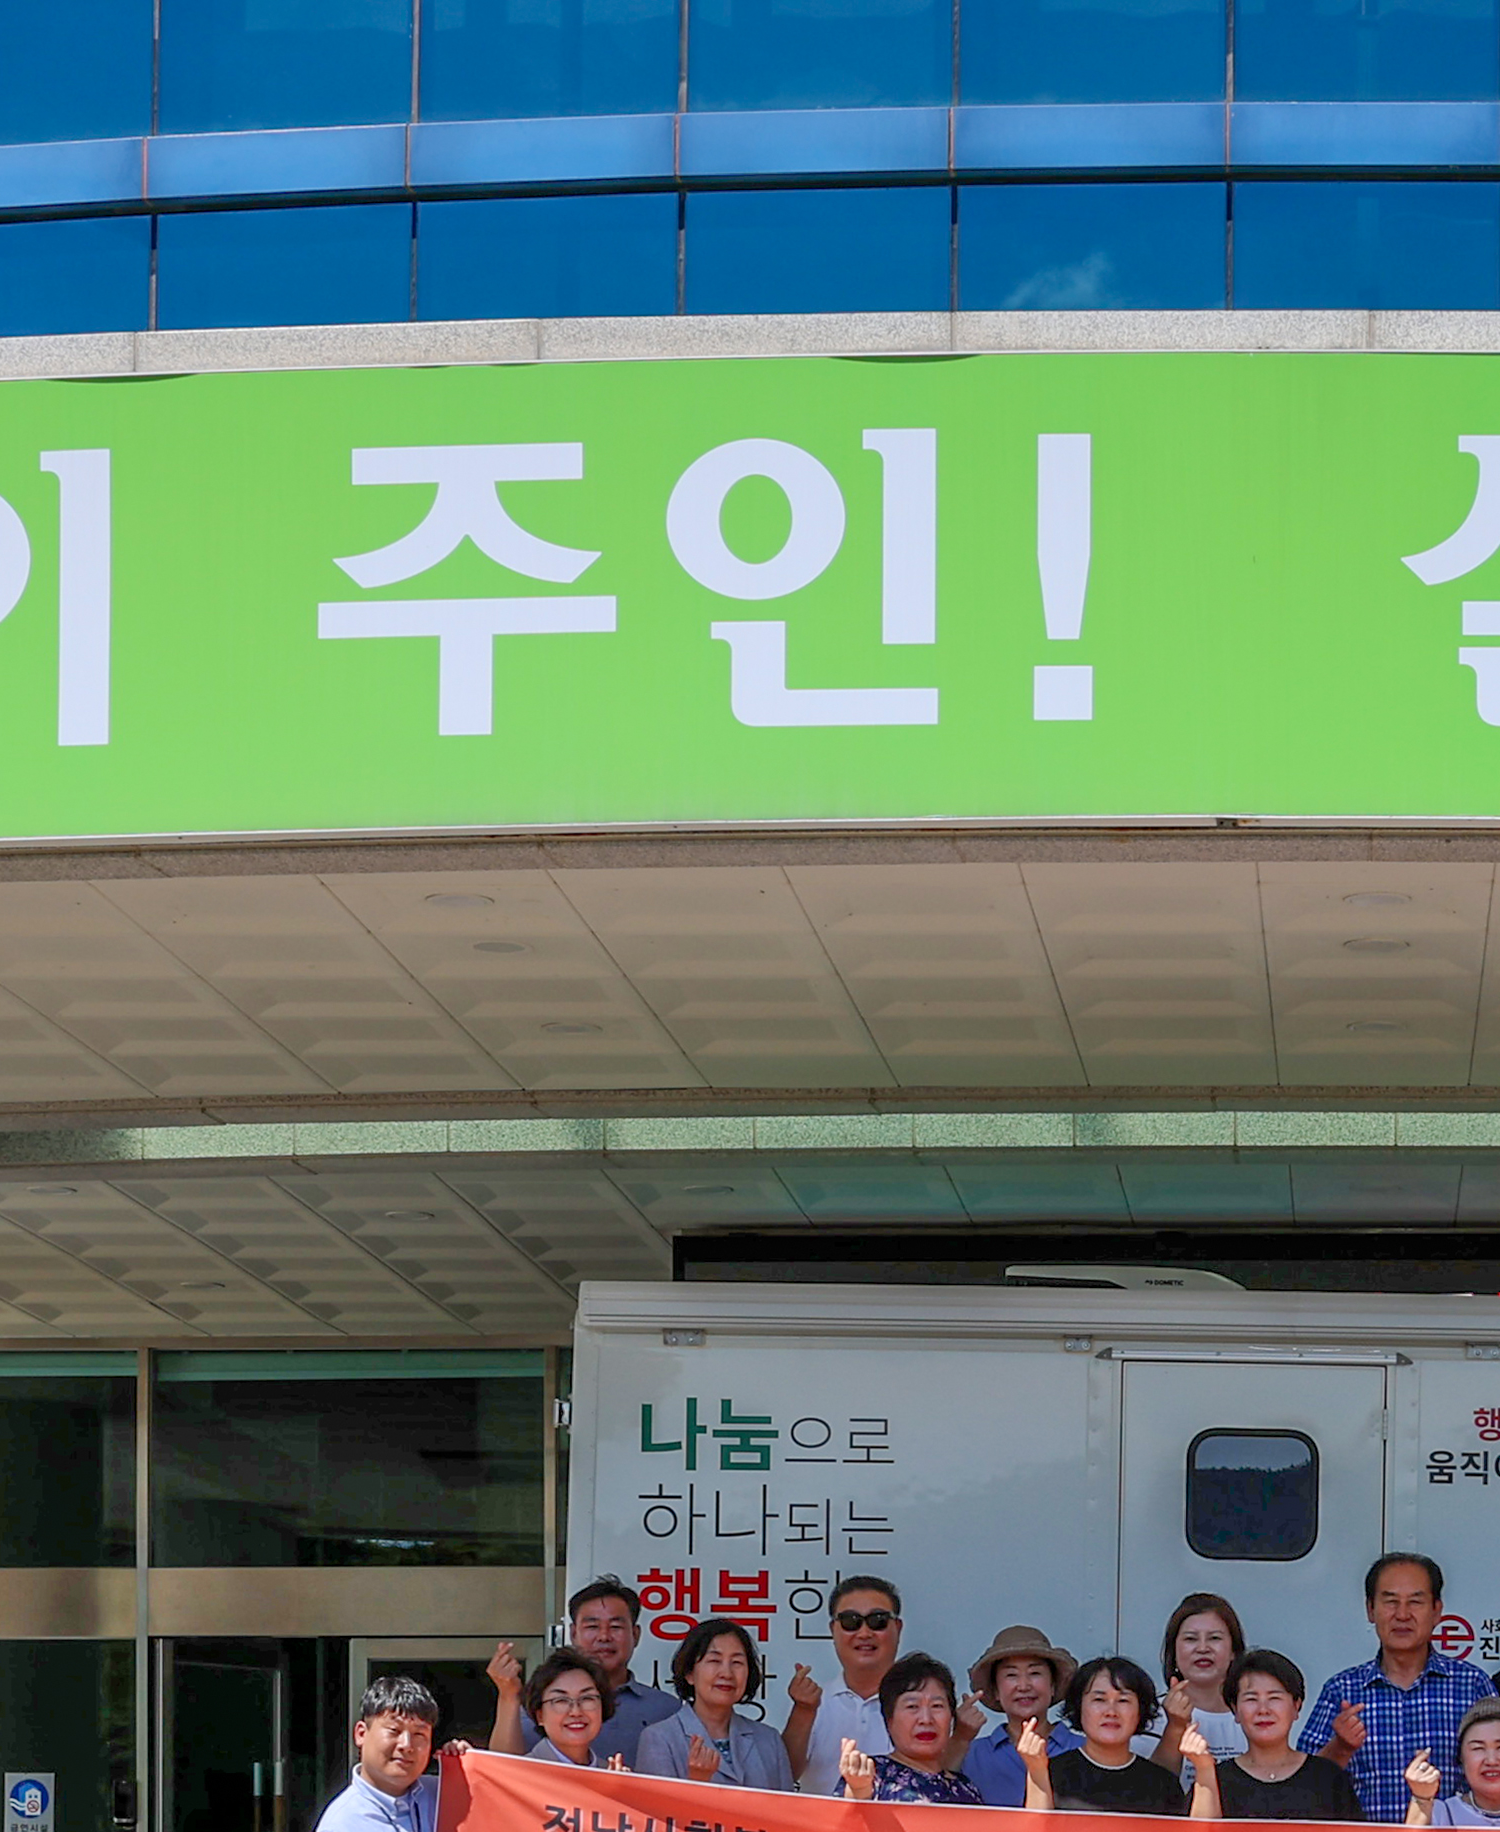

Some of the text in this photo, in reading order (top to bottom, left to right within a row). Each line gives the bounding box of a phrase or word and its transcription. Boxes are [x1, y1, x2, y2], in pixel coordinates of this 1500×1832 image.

[317, 426, 1094, 737] 주인!
[641, 1397, 894, 1471] 나눔으로
[638, 1483, 894, 1556] 하나되는
